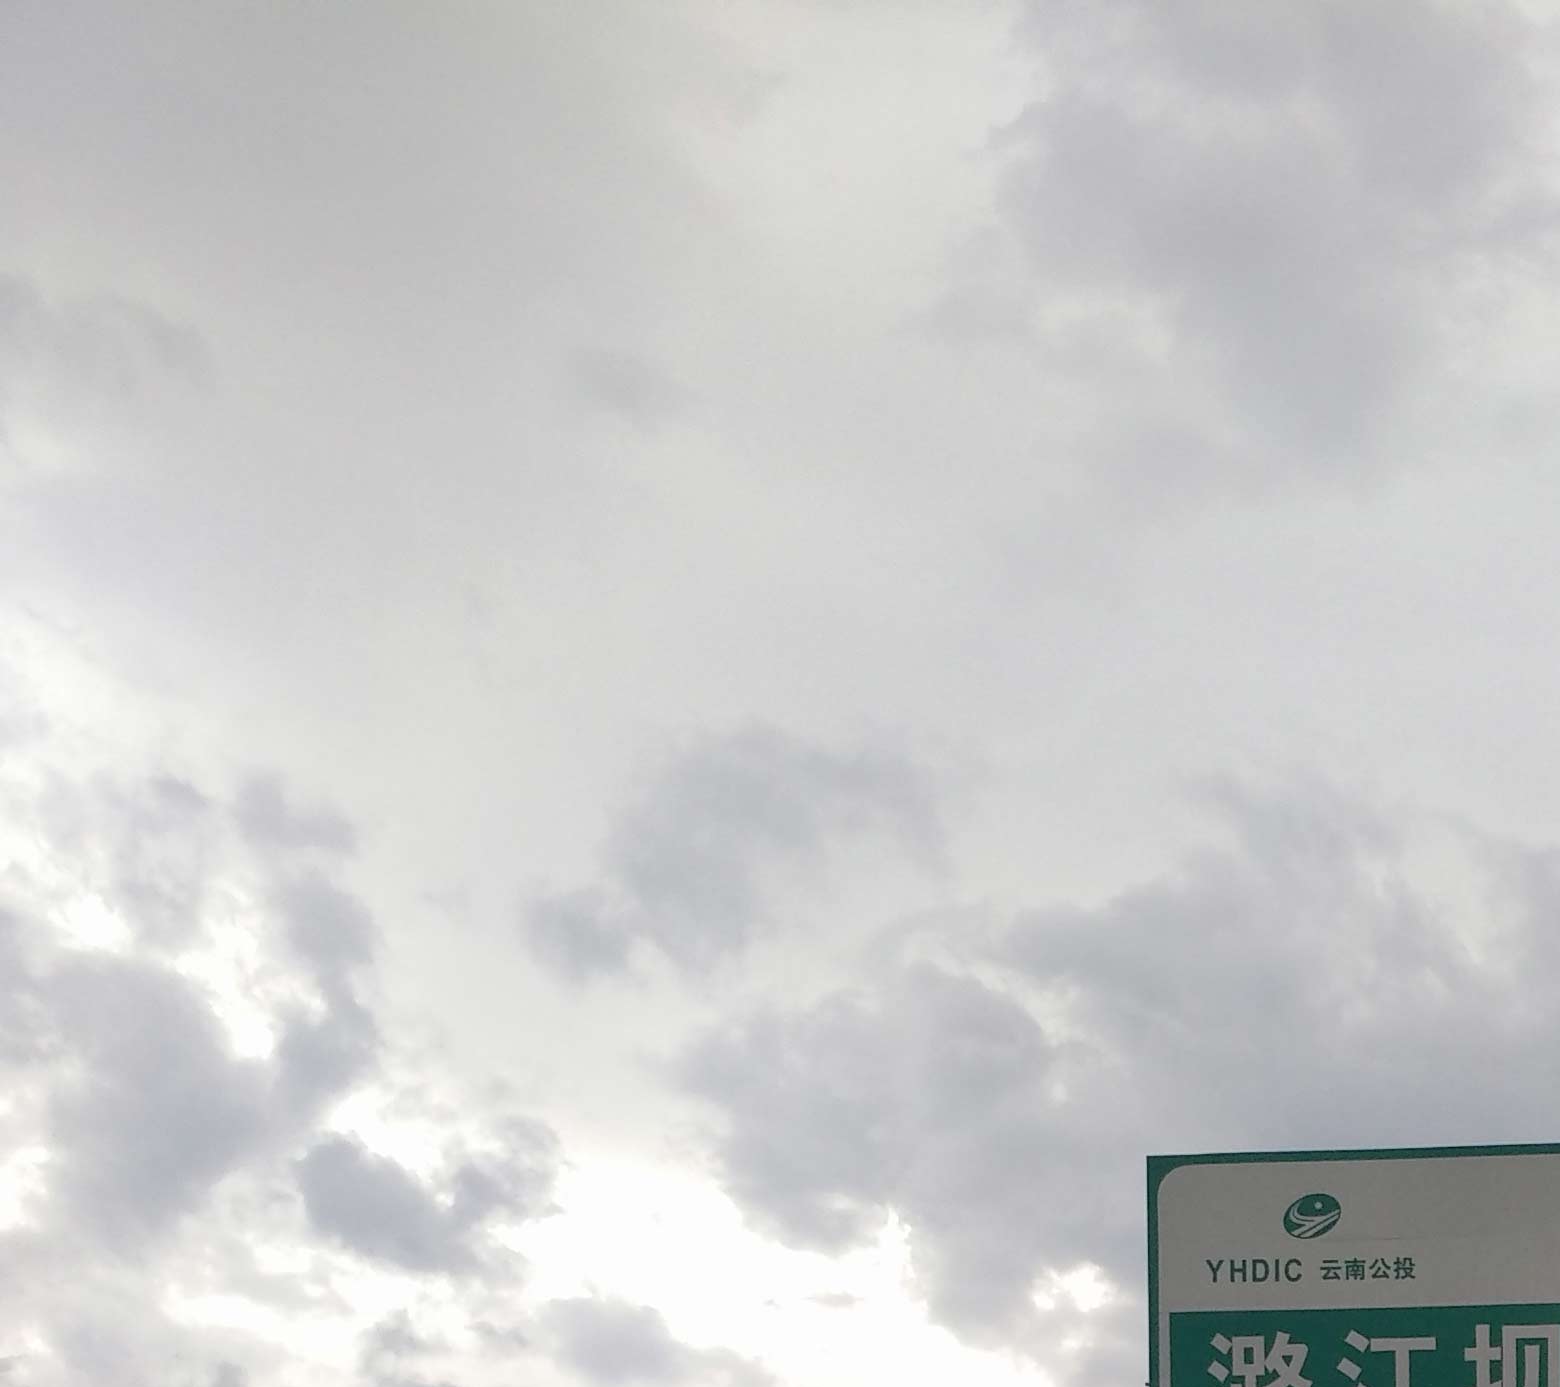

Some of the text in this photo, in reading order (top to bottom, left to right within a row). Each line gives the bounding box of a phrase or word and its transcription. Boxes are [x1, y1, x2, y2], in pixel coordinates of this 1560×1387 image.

[1205, 1258, 1303, 1284] YHDIC
[1319, 1256, 1417, 1282] 云南公投
